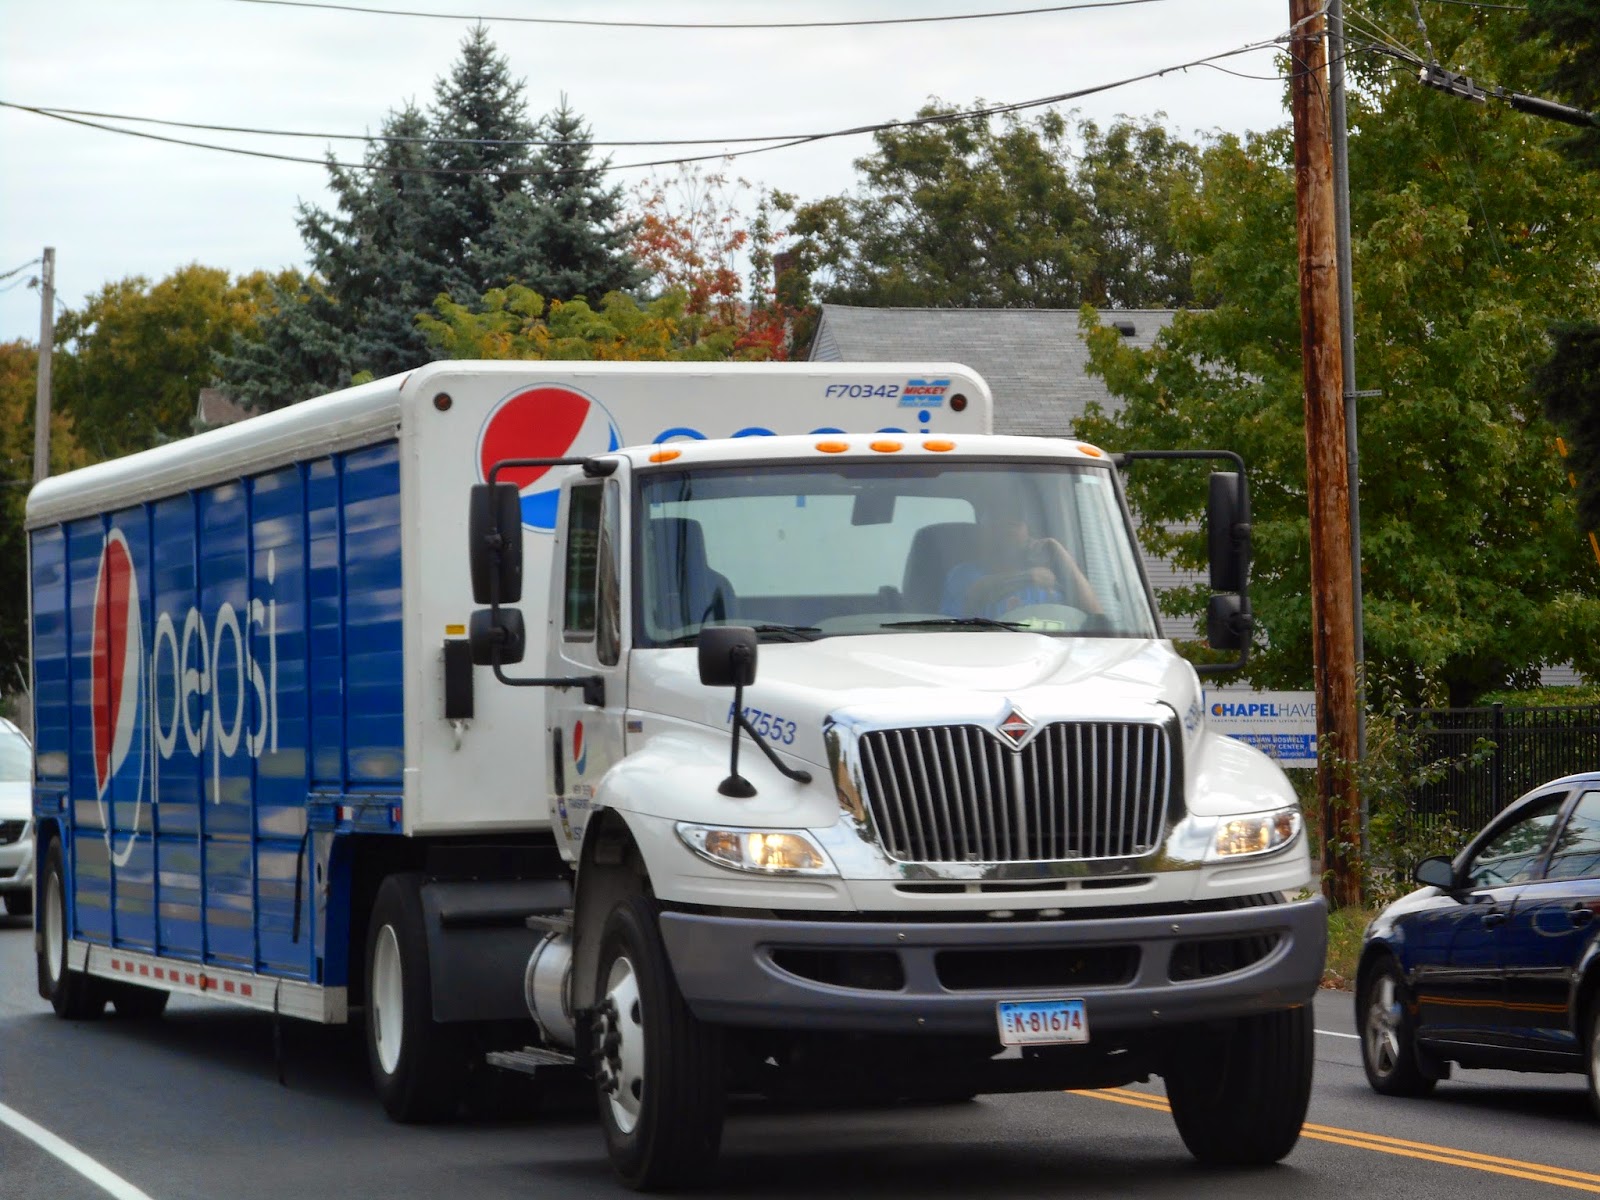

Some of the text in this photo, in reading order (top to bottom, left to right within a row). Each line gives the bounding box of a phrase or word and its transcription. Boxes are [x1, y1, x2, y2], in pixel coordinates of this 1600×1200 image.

[825, 384, 899, 398] F70342
[903, 386, 947, 395] MICKEY
[149, 549, 278, 805] pepsi
[1014, 1010, 1082, 1033] K-81674
